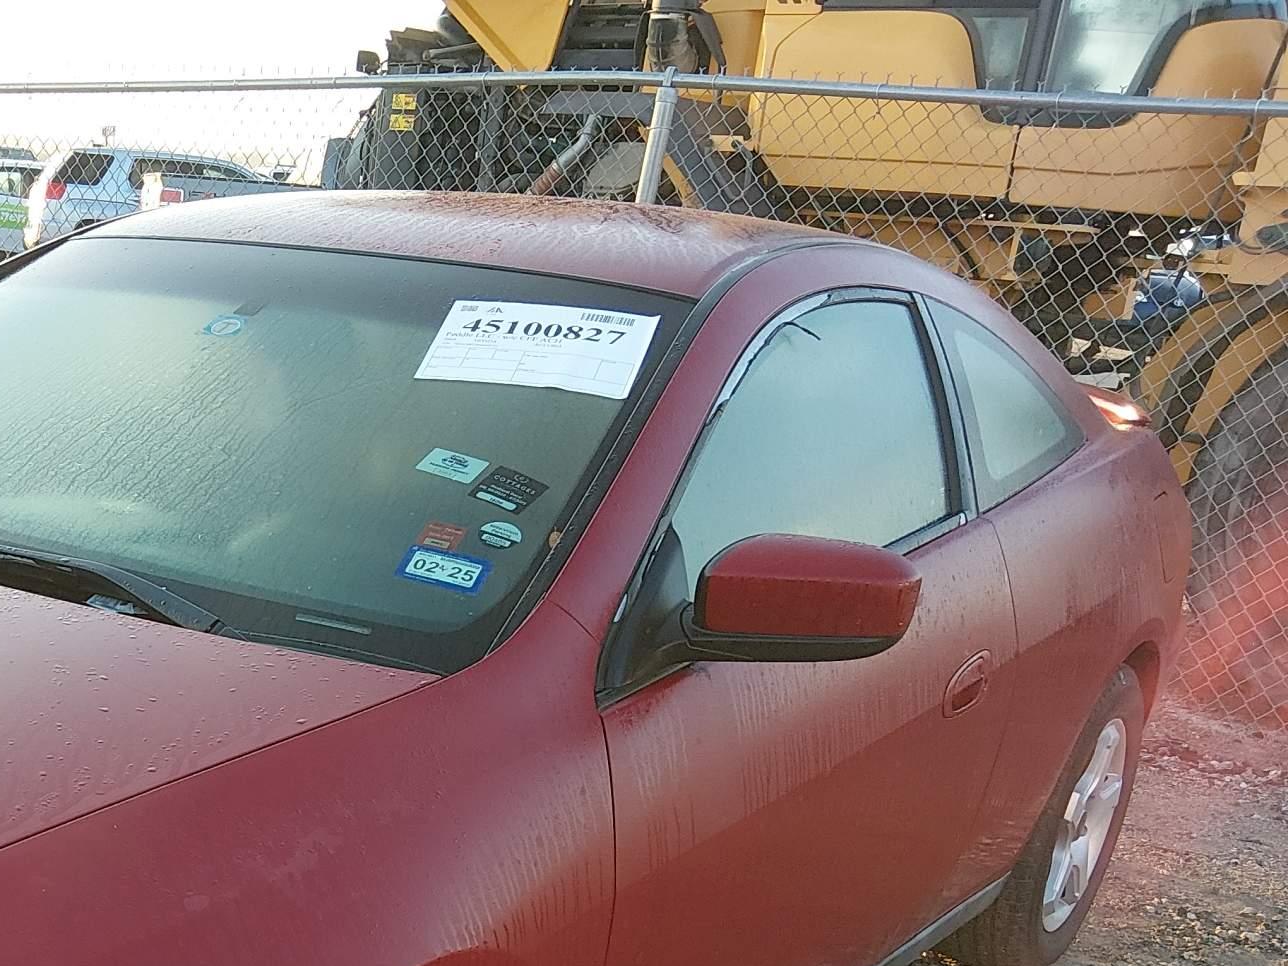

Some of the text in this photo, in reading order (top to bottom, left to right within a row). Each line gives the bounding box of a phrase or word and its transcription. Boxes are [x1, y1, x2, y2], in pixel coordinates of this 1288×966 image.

[463, 318, 627, 345] 45100827
[414, 558, 439, 574] 02
[448, 566, 476, 582] 25
